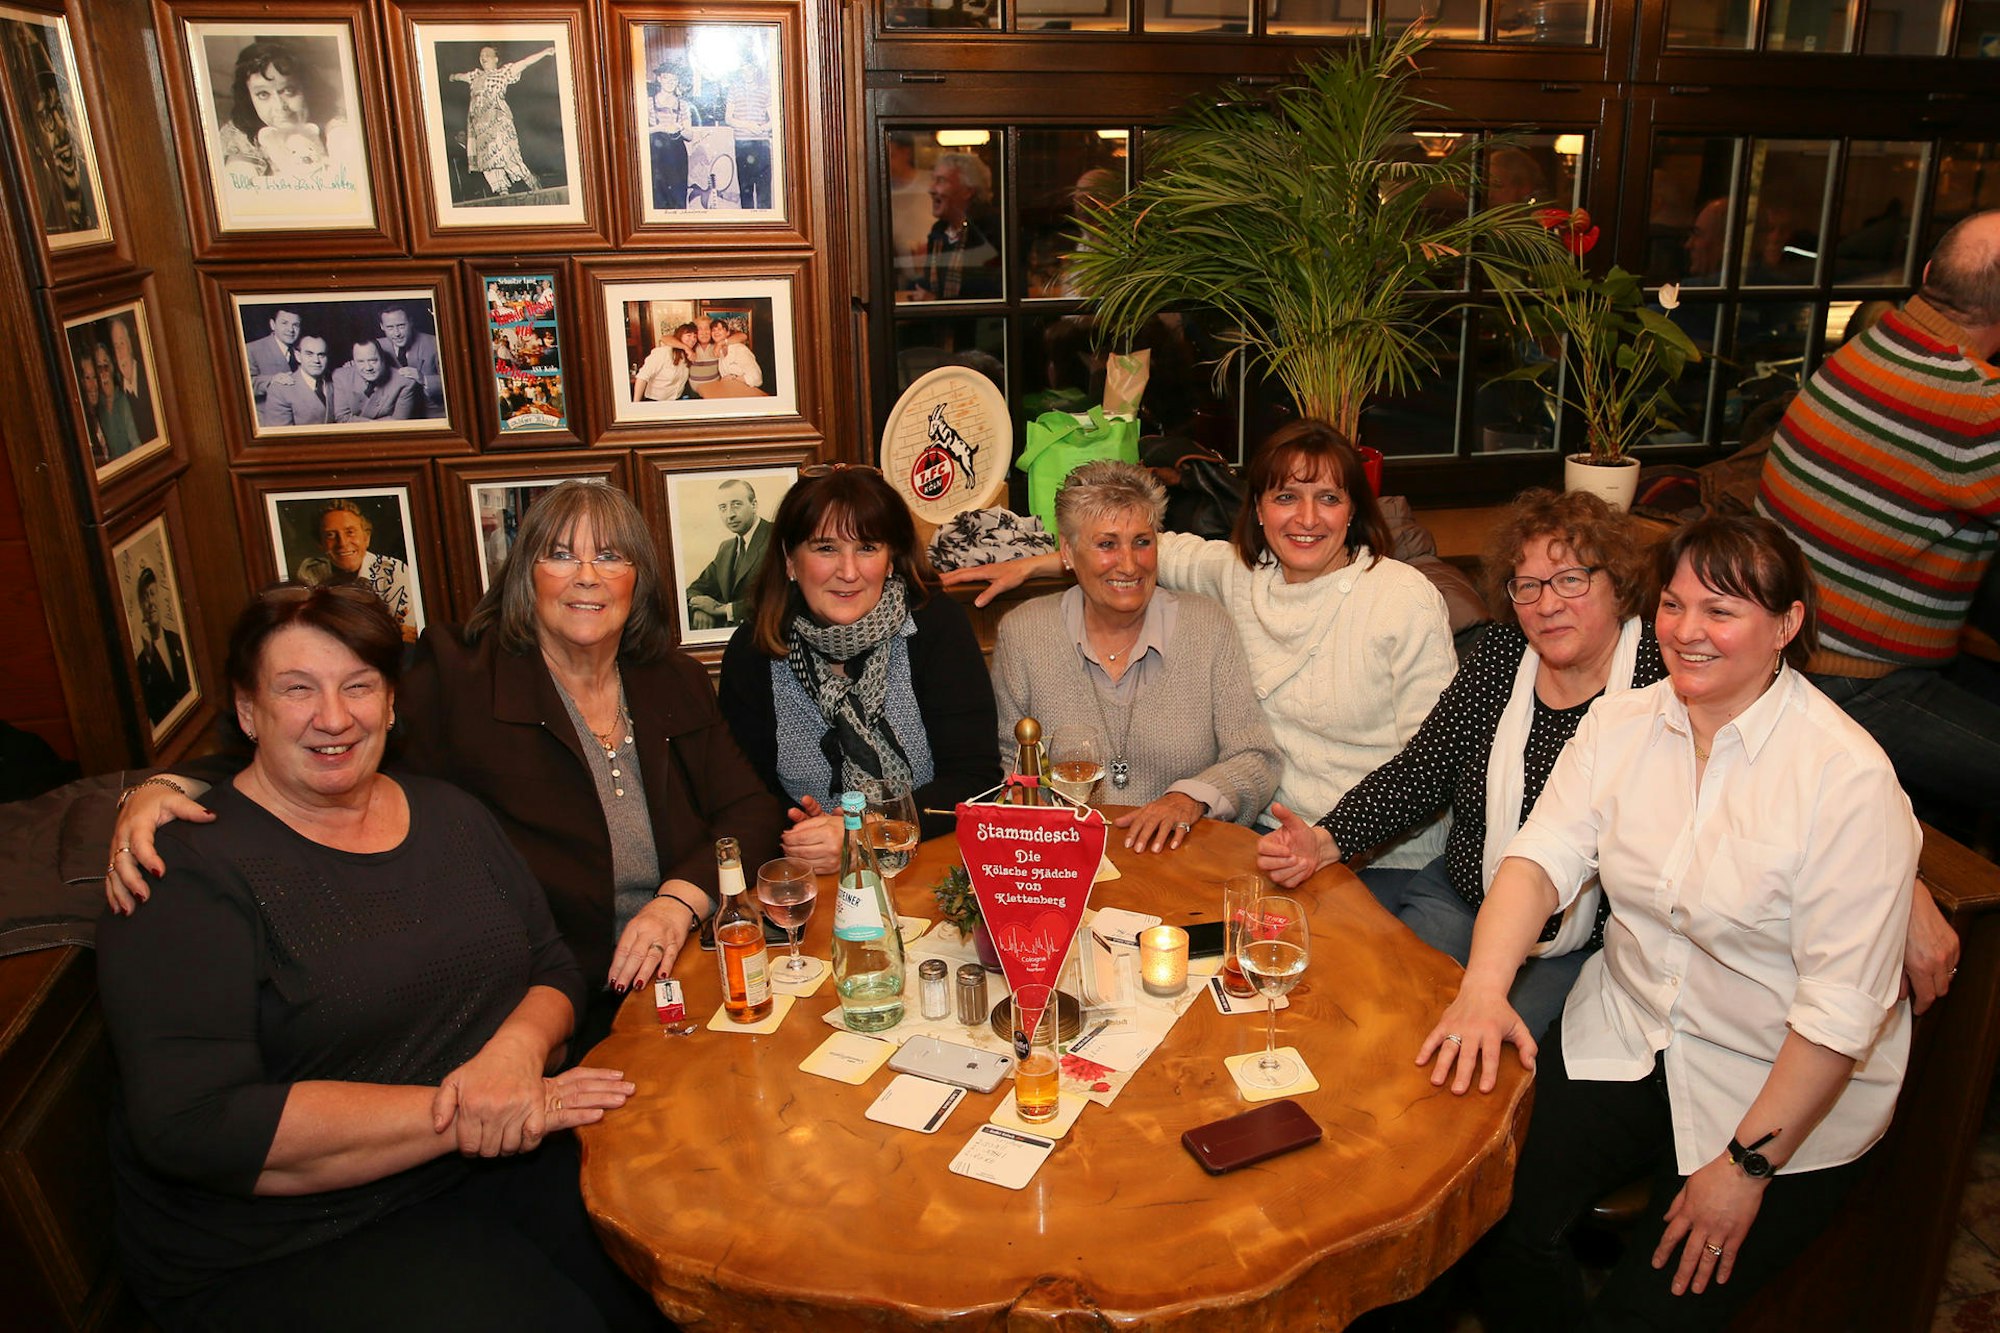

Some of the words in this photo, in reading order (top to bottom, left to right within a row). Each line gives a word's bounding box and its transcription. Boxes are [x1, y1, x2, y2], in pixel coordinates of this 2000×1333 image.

[977, 822, 1080, 843] Stammdesch
[1015, 849, 1041, 863] Die
[981, 864, 1028, 877] Kölsche
[1031, 868, 1078, 880] Mädche
[1015, 881, 1042, 891] von
[994, 893, 1066, 908] Klettenberg
